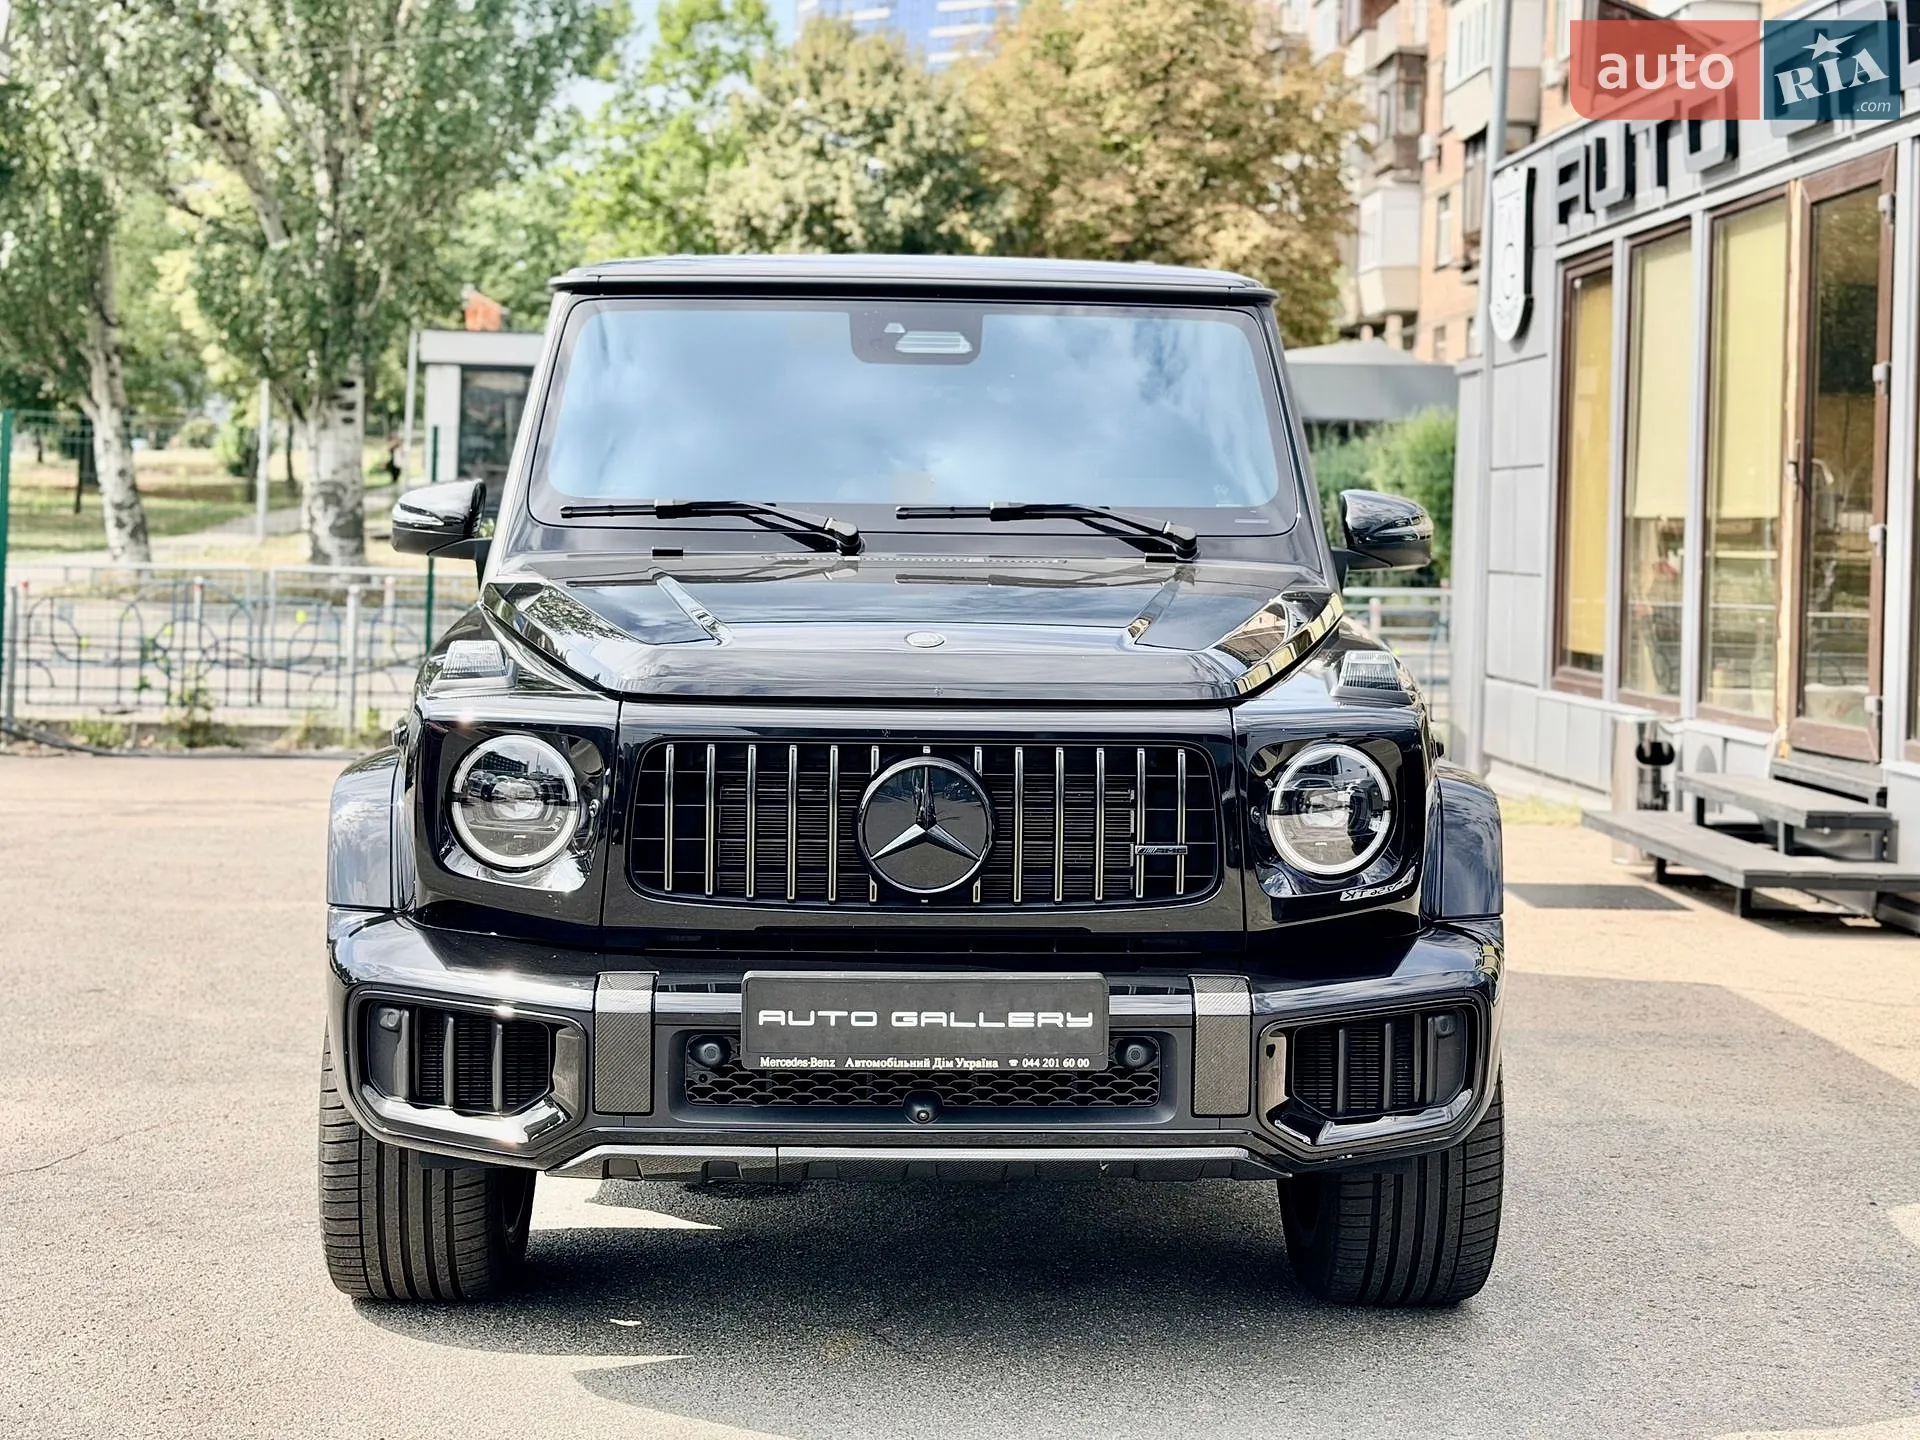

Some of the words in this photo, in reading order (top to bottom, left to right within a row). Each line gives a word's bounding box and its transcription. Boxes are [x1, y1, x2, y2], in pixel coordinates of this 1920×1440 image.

[758, 1009, 878, 1027] AUTO
[891, 1011, 1093, 1028] GALLERY
[759, 1056, 836, 1068] Mercedes-Benz
[845, 1057, 931, 1068] Автомобільний
[932, 1057, 954, 1068] Дім
[954, 1057, 999, 1070] Україна
[1021, 1057, 1041, 1068] 044
[1042, 1057, 1060, 1068] 201
[1062, 1057, 1076, 1068] 60
[1076, 1057, 1091, 1068] 00
